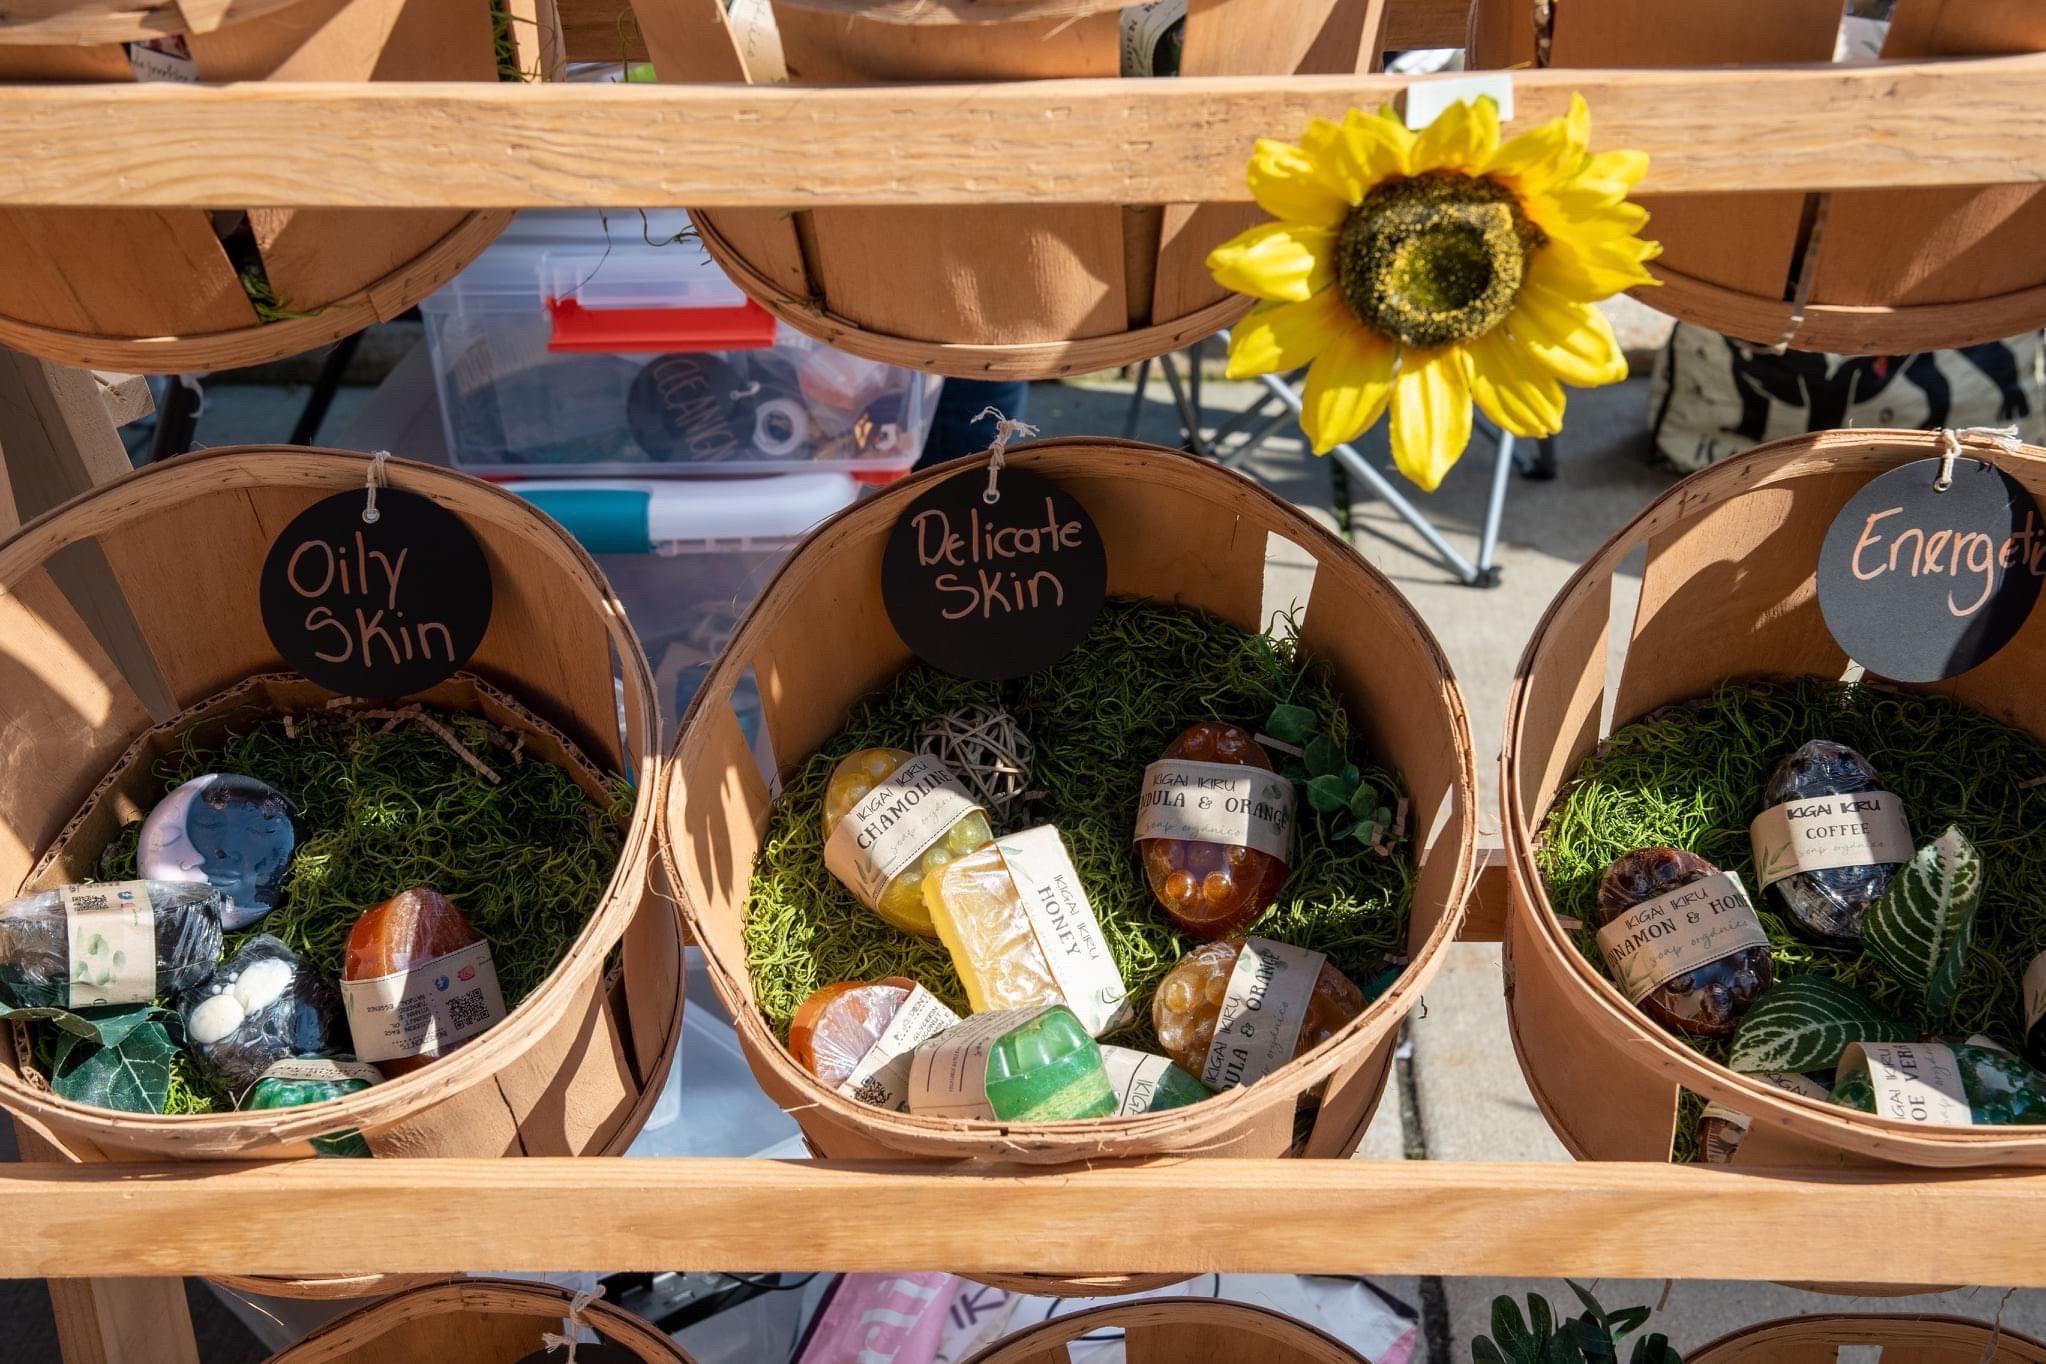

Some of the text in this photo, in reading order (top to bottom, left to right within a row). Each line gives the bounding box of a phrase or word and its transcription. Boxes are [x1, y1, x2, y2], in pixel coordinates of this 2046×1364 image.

[911, 496, 1082, 566] Delicate
[287, 530, 408, 610] Oily
[1197, 776, 1236, 793] IKIRU
[1198, 796, 1213, 810] &
[1786, 803, 1832, 821] IKIGAI
[1806, 822, 1872, 840] COFFEE
[1036, 884, 1082, 957] HONEY
[1624, 887, 1709, 930] IKIGAI IKIRU
[1685, 911, 1701, 925] &
[1076, 922, 1100, 962] IKIRU
[1245, 951, 1281, 1012] ORANGE
[1219, 993, 1241, 1035] IKIRU
[1240, 1022, 1255, 1038] &
[1129, 1079, 1154, 1116] IKIG
